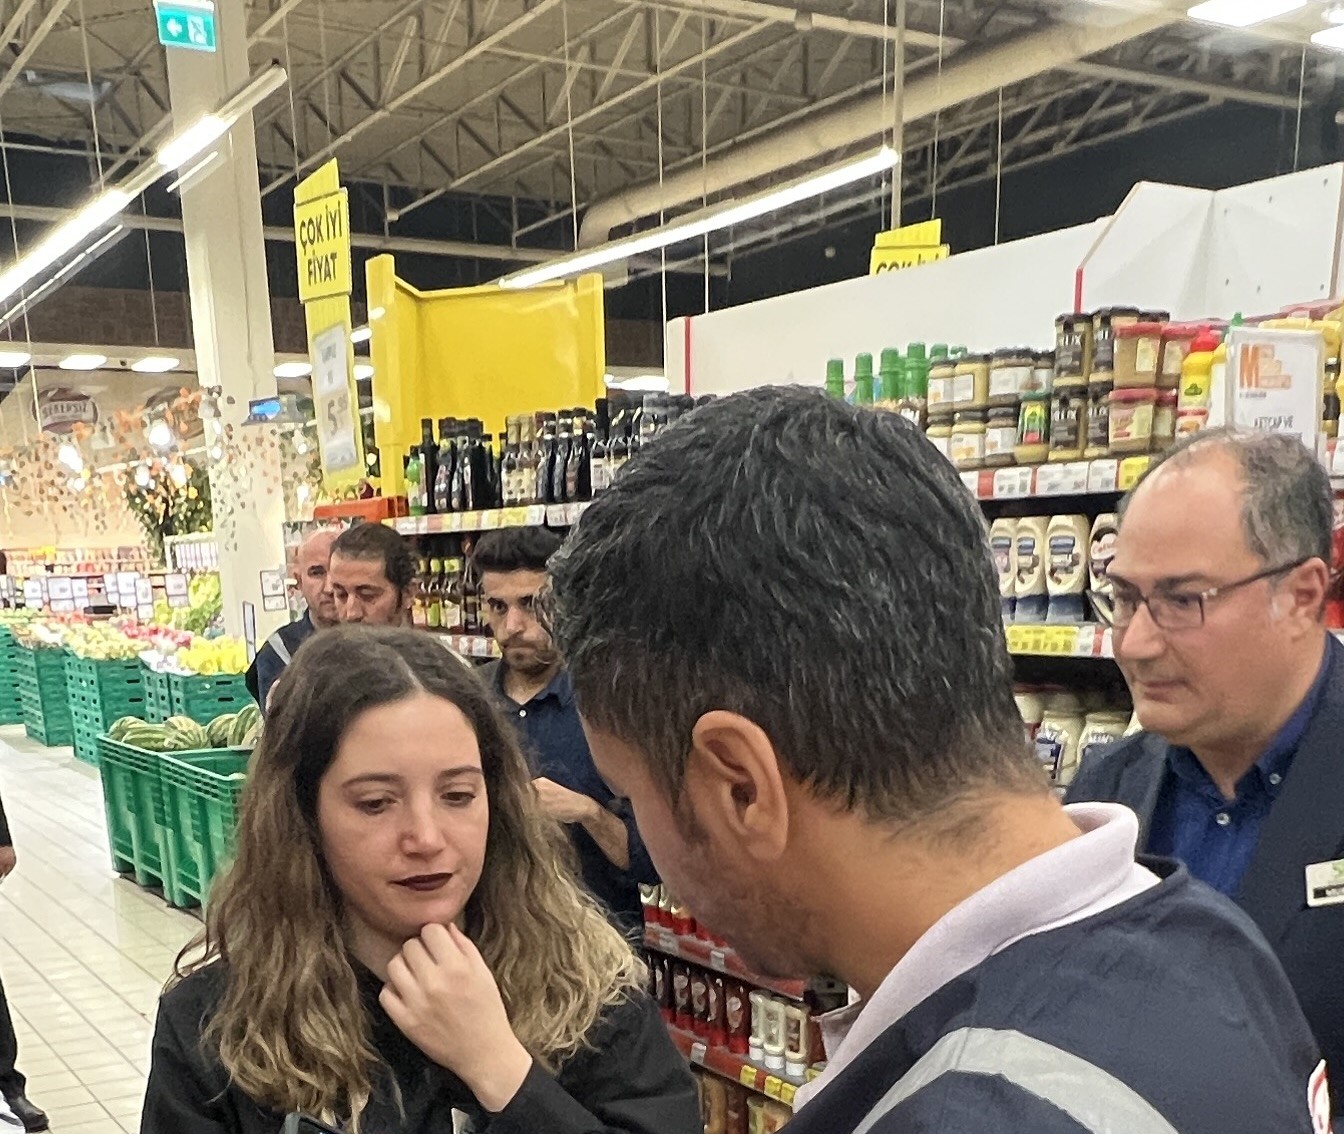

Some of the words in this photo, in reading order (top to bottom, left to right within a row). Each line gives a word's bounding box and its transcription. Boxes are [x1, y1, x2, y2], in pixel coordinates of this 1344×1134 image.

[299, 213, 324, 255] ÇOK
[325, 200, 342, 240] İYİ
[307, 250, 338, 286] FİYAT
